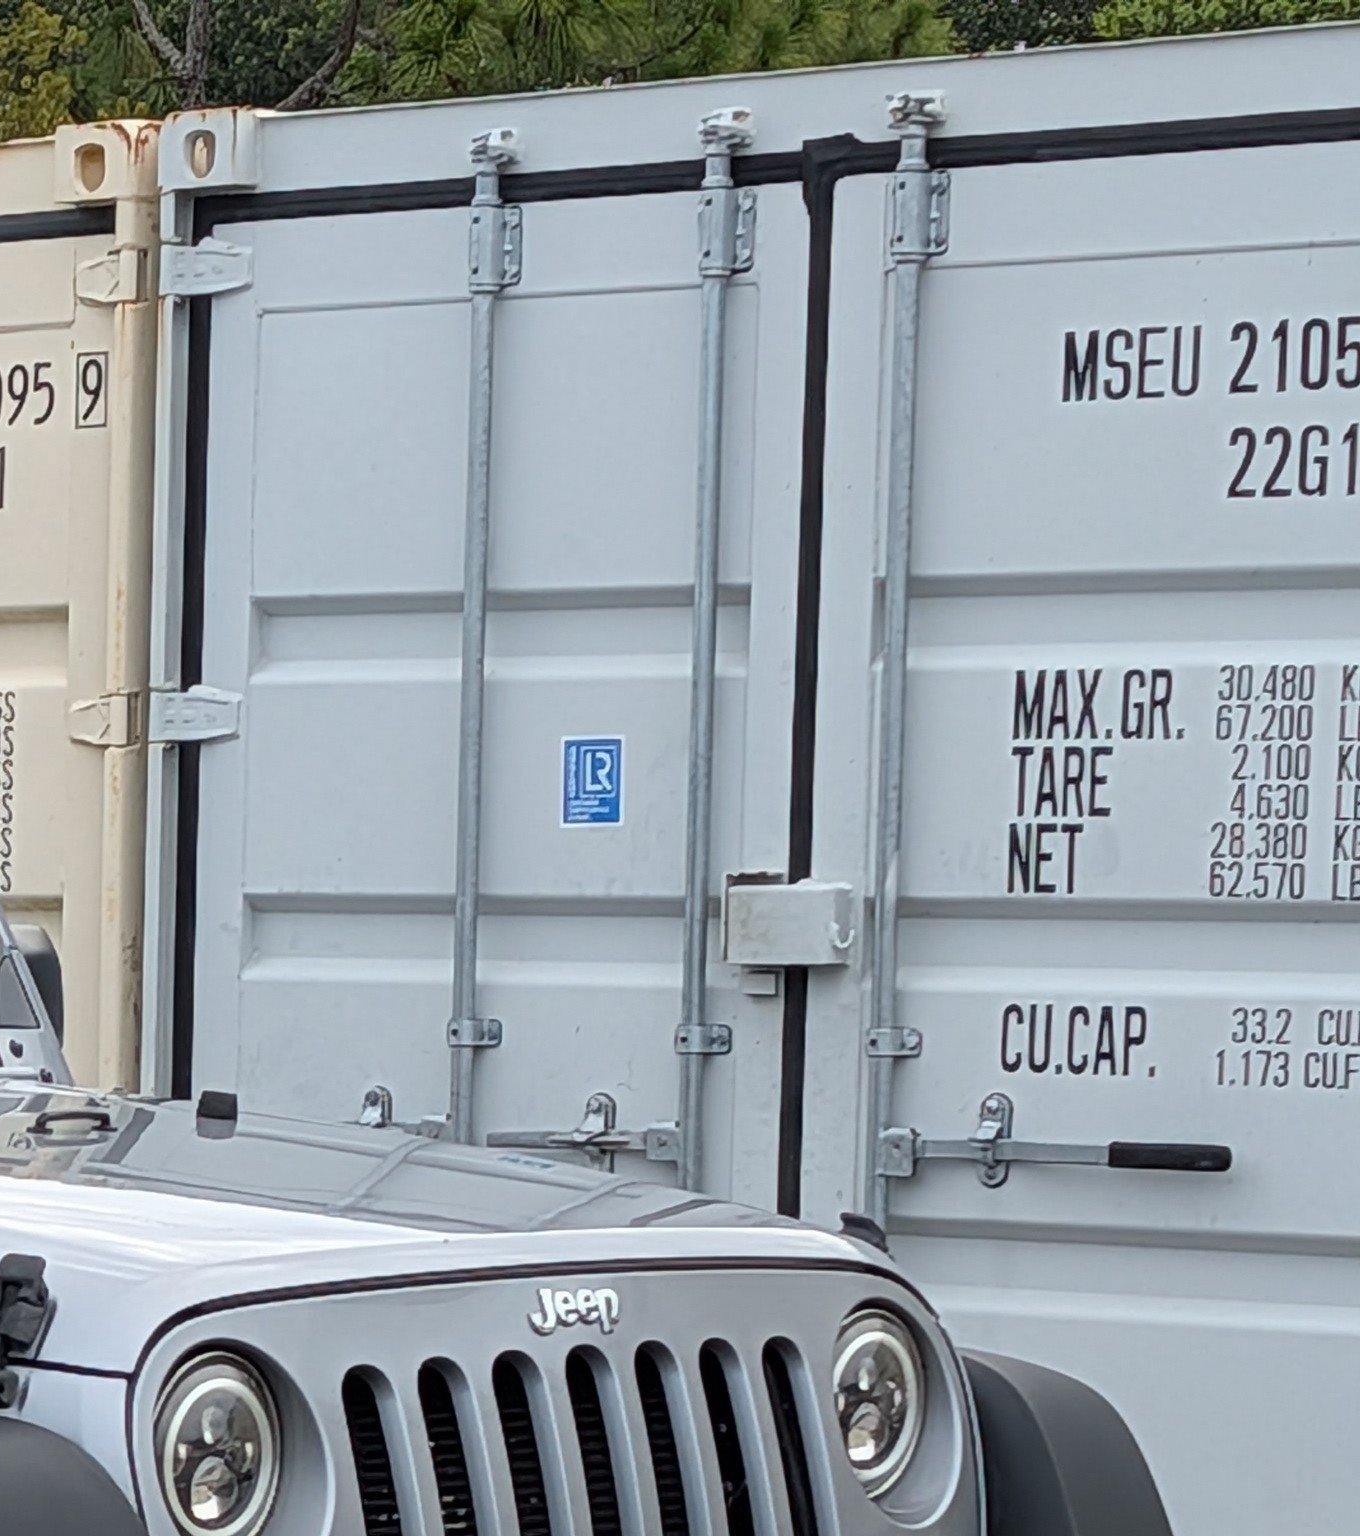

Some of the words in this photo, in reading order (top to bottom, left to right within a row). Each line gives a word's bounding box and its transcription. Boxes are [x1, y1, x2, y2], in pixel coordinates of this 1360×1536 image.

[81, 358, 103, 422] 9
[1061, 324, 1202, 403] MSEU
[1228, 315, 1360, 394] 2105
[1226, 422, 1360, 499] 22G1
[1012, 668, 1186, 740] MAX.GR.
[1340, 664, 1360, 702] K
[1338, 705, 1360, 741] L
[1011, 746, 1114, 817] TARE
[1006, 822, 1084, 894] NET
[1000, 1003, 1156, 1078] CU.CAP.
[527, 1287, 620, 1337] Jeep
